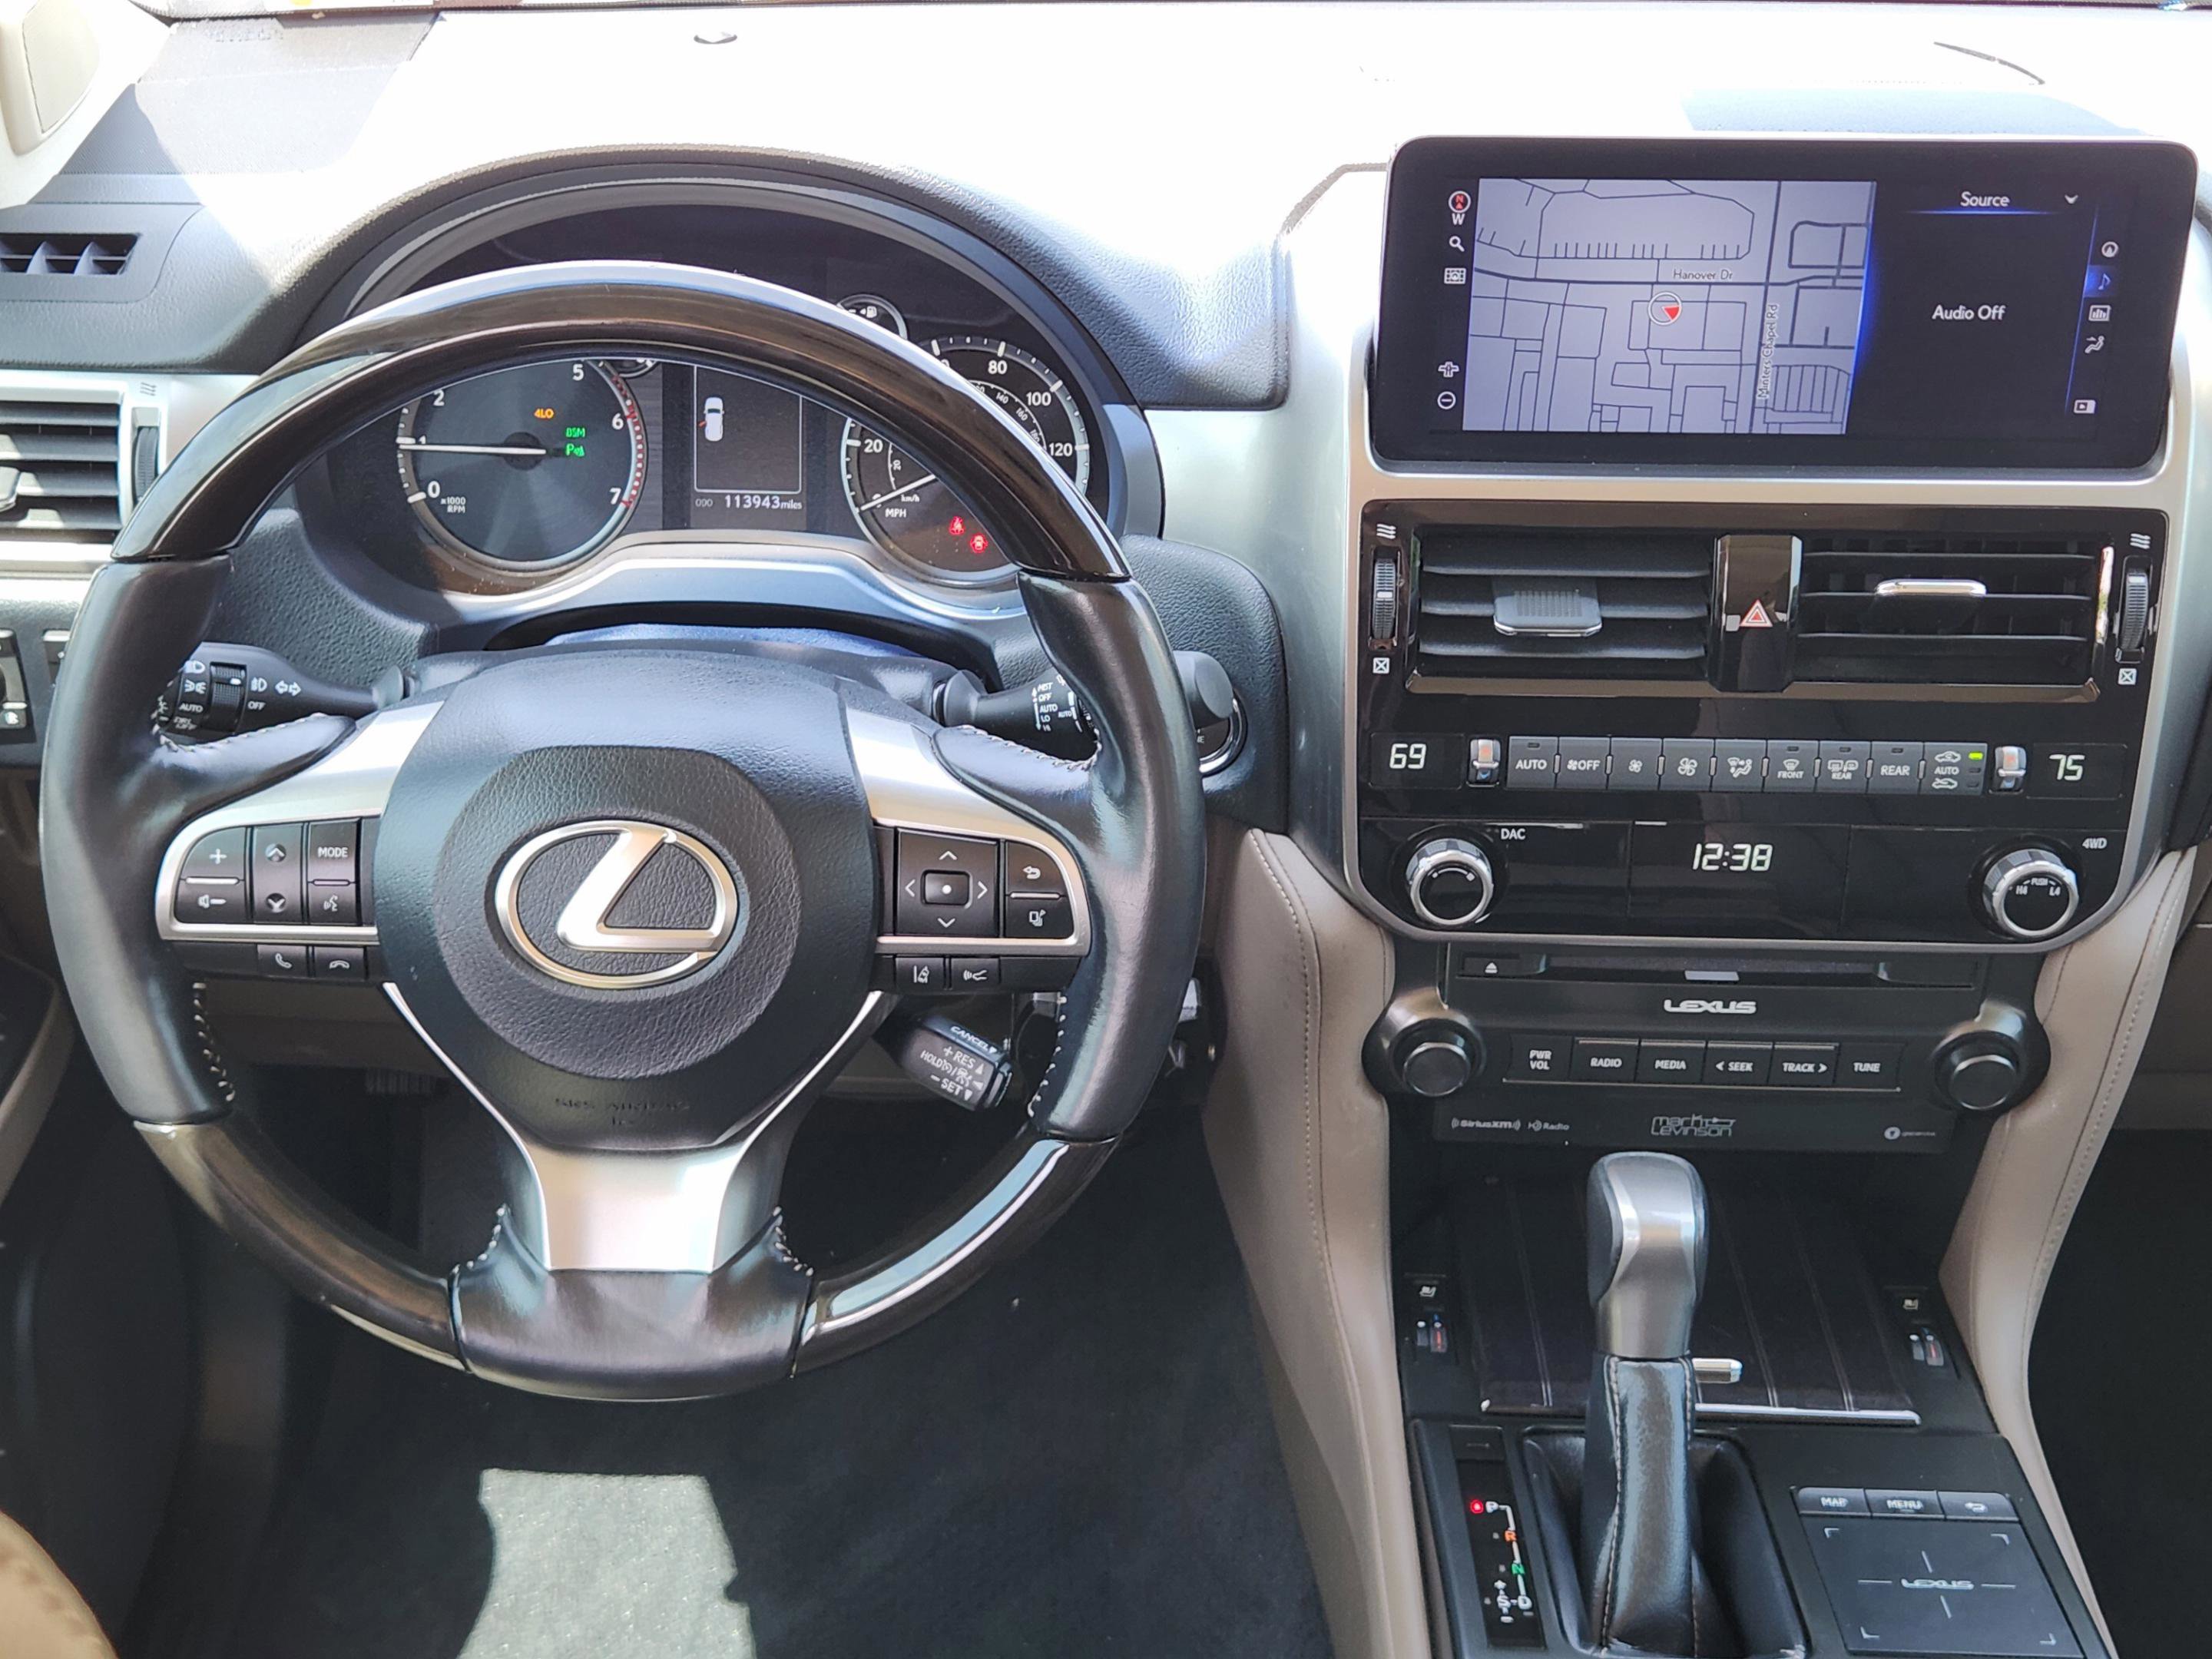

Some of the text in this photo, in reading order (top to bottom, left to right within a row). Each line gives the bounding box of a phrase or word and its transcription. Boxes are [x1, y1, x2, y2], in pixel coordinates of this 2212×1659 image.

[1960, 191, 2011, 207] Source
[1673, 269, 1733, 280] Hanover Dr
[1932, 304, 2006, 320] Audio Off
[1757, 304, 1778, 399] Minters Chapel Rd
[572, 363, 584, 382] 5
[988, 359, 1008, 375] 80
[995, 392, 1009, 405] 140
[1025, 392, 1051, 406] 100
[534, 409, 555, 419] 4LO
[1015, 408, 1028, 422] 160
[611, 412, 624, 430] 6
[864, 439, 883, 453] 20
[1048, 442, 1073, 457] 120
[609, 488, 621, 505] 7
[724, 494, 780, 510] 113943
[446, 505, 466, 514] RPM
[885, 508, 907, 518] MPH
[1037, 682, 1054, 692] MIST
[1038, 692, 1052, 703] OFF
[178, 703, 204, 714] AUTO
[247, 700, 267, 711] OFF
[1039, 704, 1058, 713] AUTO
[1389, 742, 1427, 770] 69
[1515, 758, 1548, 771] AUTO
[1577, 760, 1601, 771] OFF
[1880, 764, 1911, 777] REAR
[1933, 765, 1960, 777] AUTO
[2048, 753, 2085, 782] 75
[1777, 770, 1804, 780] FRONT
[1830, 771, 1853, 780] REAR
[1500, 827, 1526, 841] DAC
[2081, 837, 2108, 849] 4WD
[317, 846, 349, 859] MODE
[1691, 843, 1773, 873] 12:38
[1663, 998, 1757, 1015] LEXUS
[950, 1025, 989, 1052] CANCEL
[920, 1049, 943, 1069] HOLD
[952, 1050, 976, 1069] RES
[1529, 1049, 1552, 1060] PWR
[1529, 1060, 1551, 1071] VOL
[1590, 1057, 1623, 1068] RADIO
[1654, 1059, 1687, 1071] MEDIA
[1727, 1061, 1753, 1073] SEEK
[1782, 1061, 1816, 1074] TRACK
[1853, 1061, 1881, 1073] TUNE
[940, 1078, 964, 1096] SET
[1820, 1496, 1849, 1508] MAP
[1886, 1498, 1924, 1511] MENU
[1900, 1578, 1975, 1591] LEXUS
